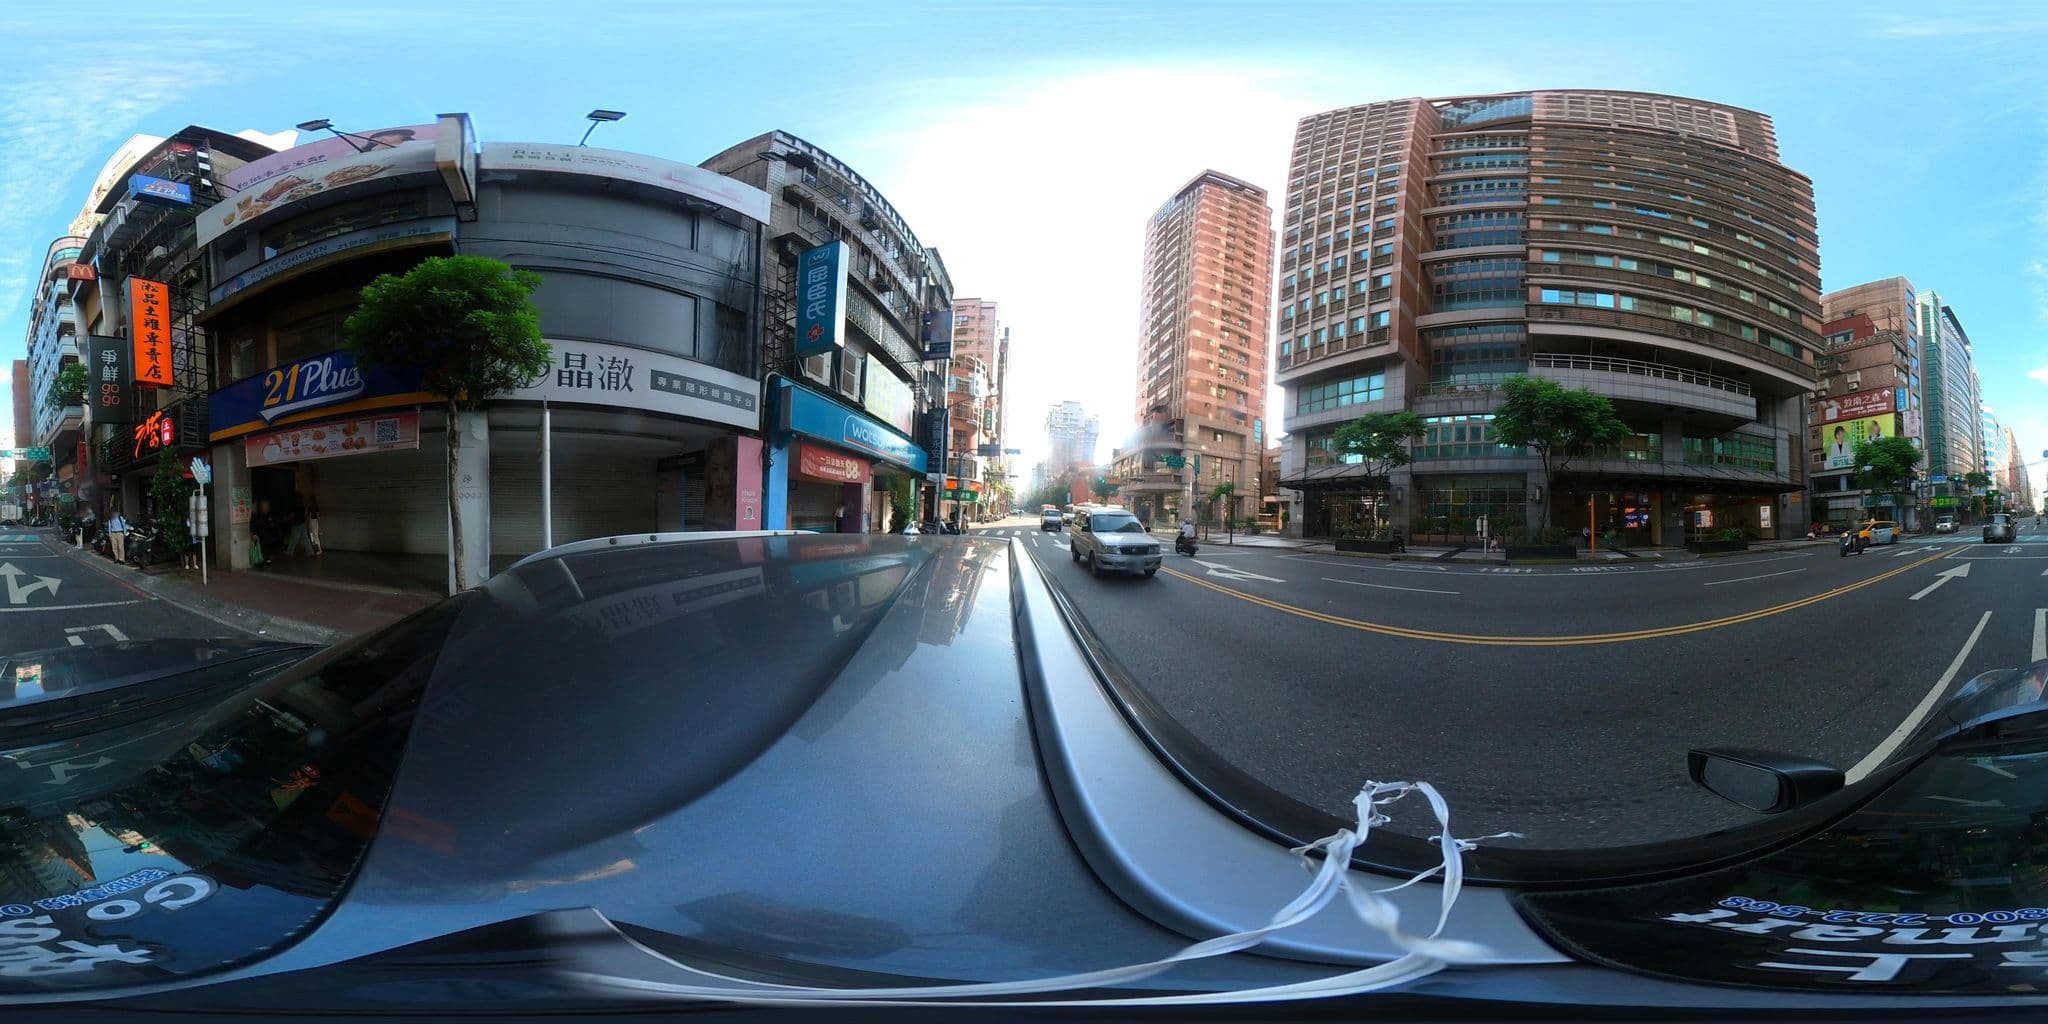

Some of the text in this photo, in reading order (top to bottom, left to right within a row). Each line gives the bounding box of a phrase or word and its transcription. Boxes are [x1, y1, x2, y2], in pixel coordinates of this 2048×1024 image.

[806, 265, 828, 320] 屈臣氏
[101, 383, 120, 395] go
[557, 352, 634, 392] 晶澈
[102, 395, 120, 406] go
[86, 876, 210, 921] Go
